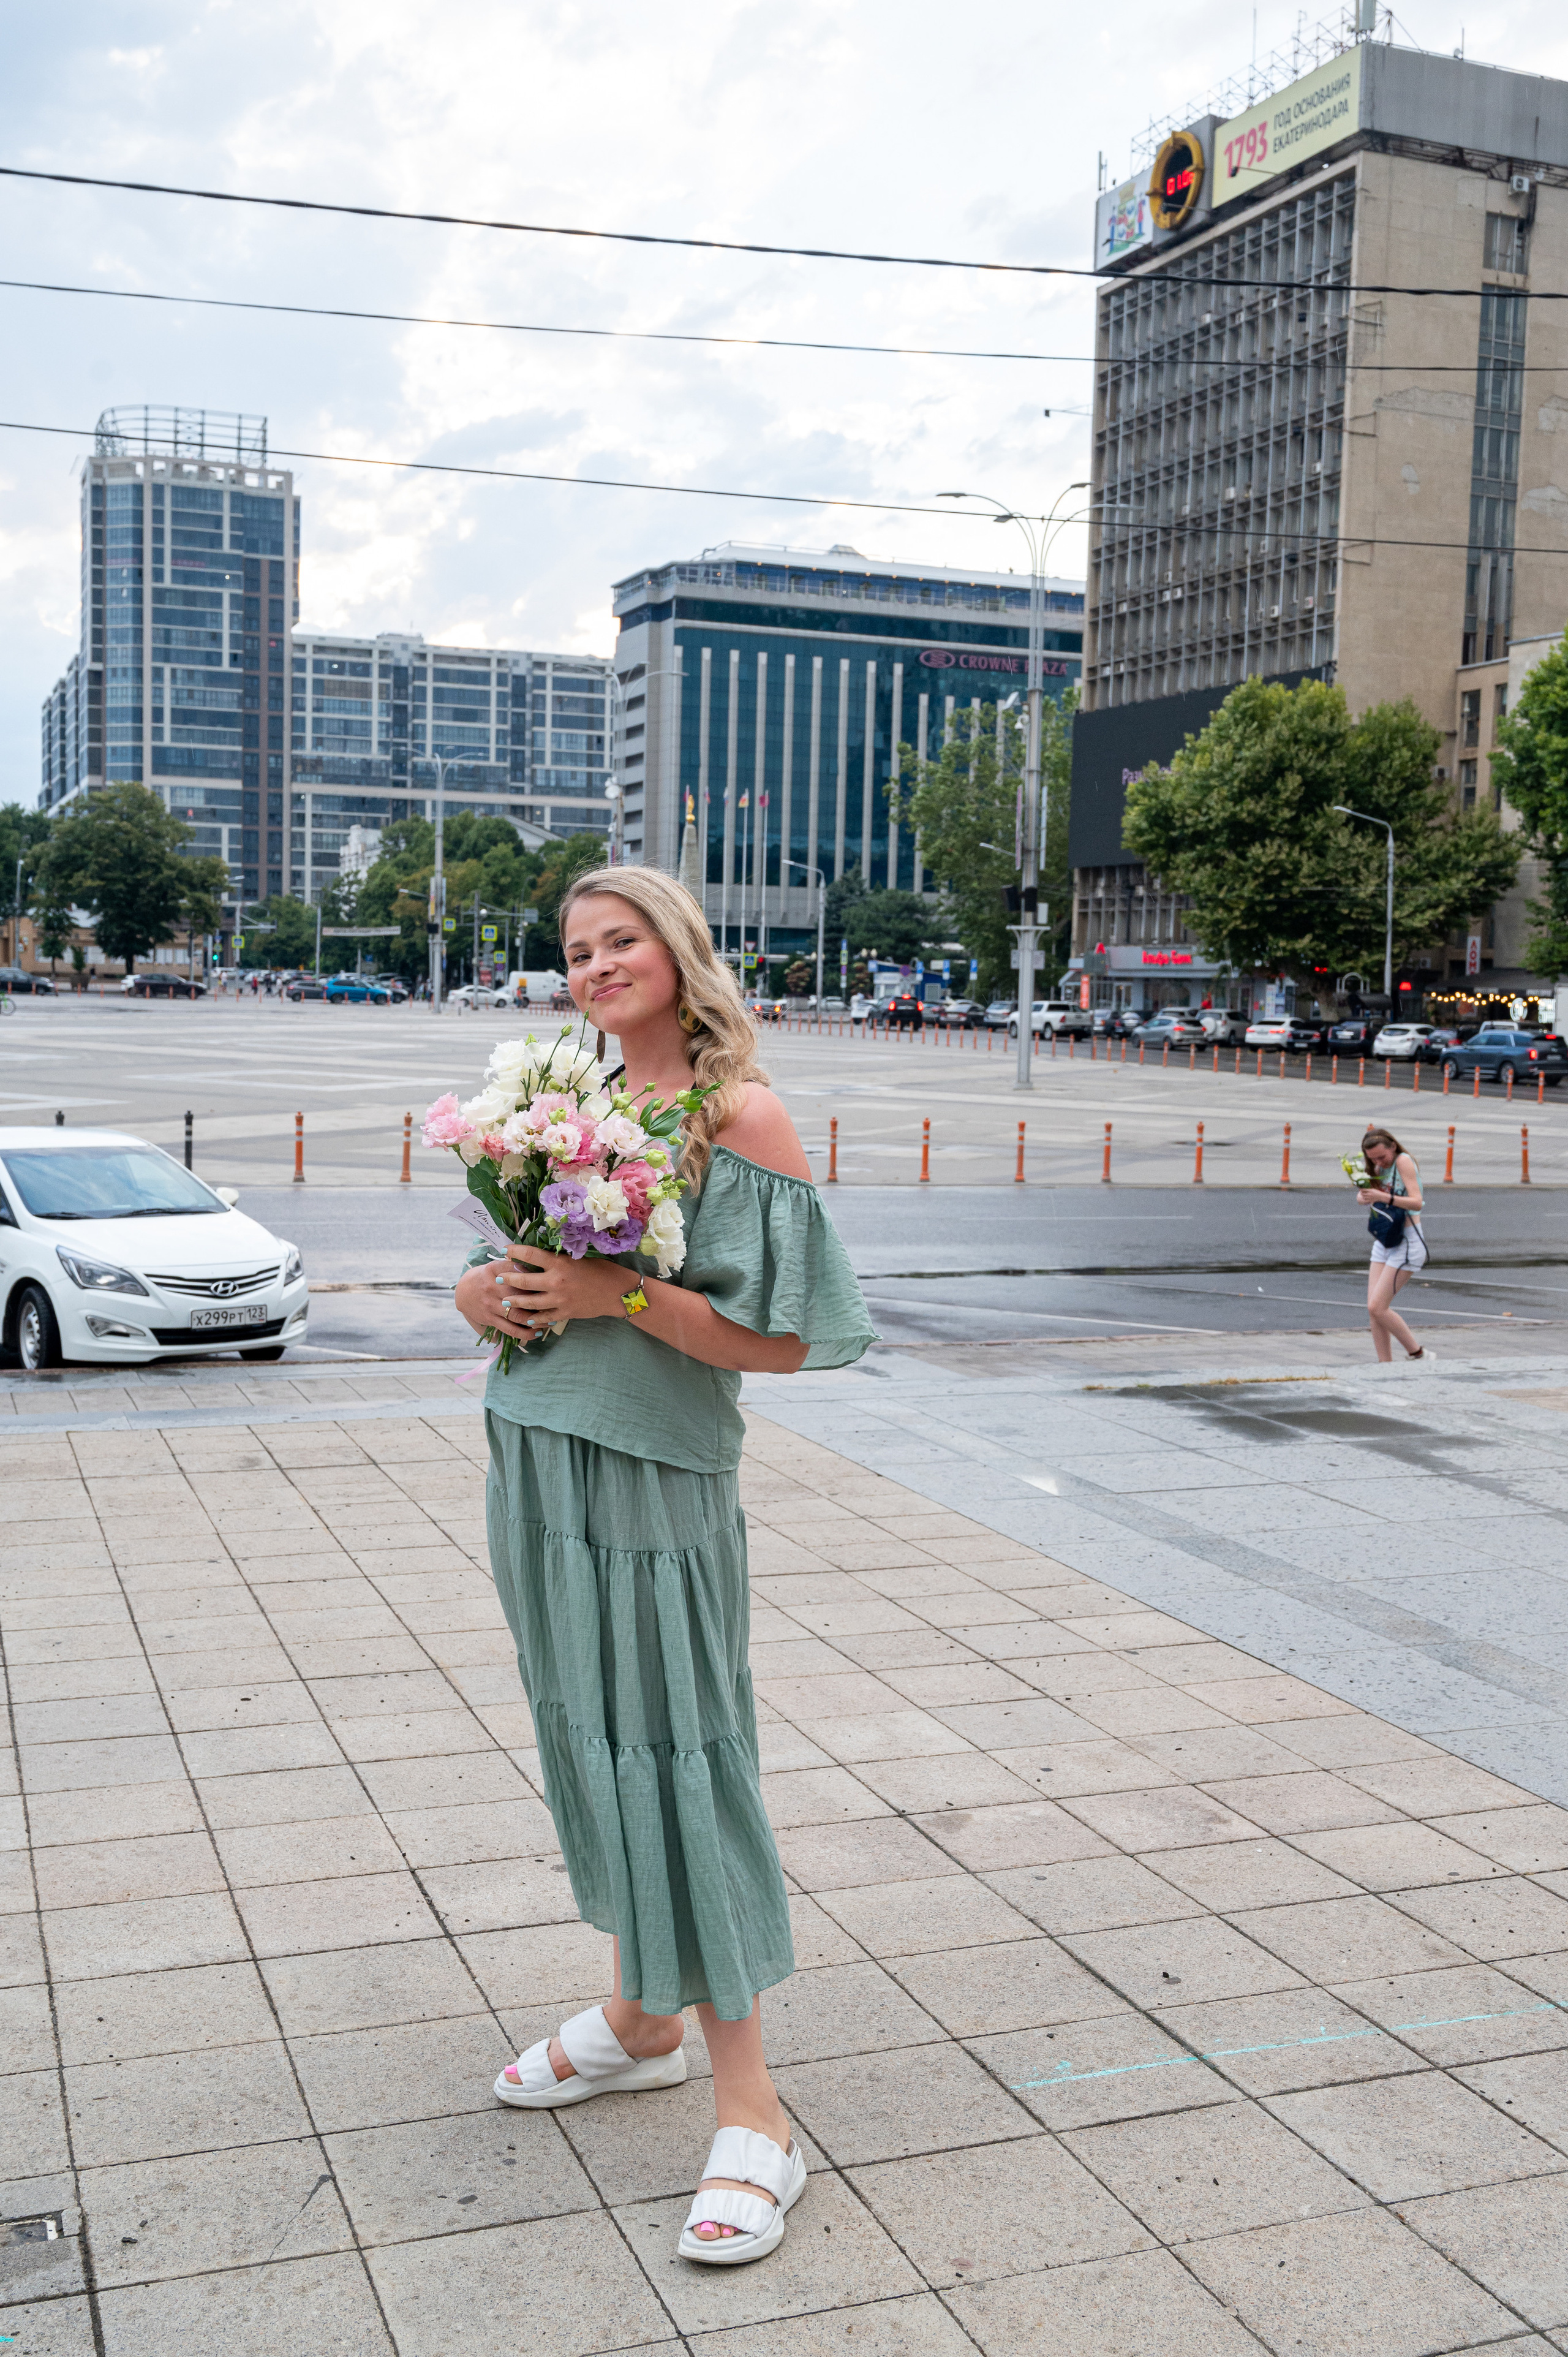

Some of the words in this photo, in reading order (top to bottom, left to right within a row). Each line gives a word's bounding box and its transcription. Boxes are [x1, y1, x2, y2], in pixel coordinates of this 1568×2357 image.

[1273, 107, 1292, 130] ГОД
[1294, 72, 1351, 119] ОСНОВАНИЯ
[1273, 98, 1349, 153] ЕКАТЕРИНОДАРА
[1224, 121, 1268, 178] 1793
[959, 654, 1019, 672] CROWNE
[247, 1307, 264, 1318] 123
